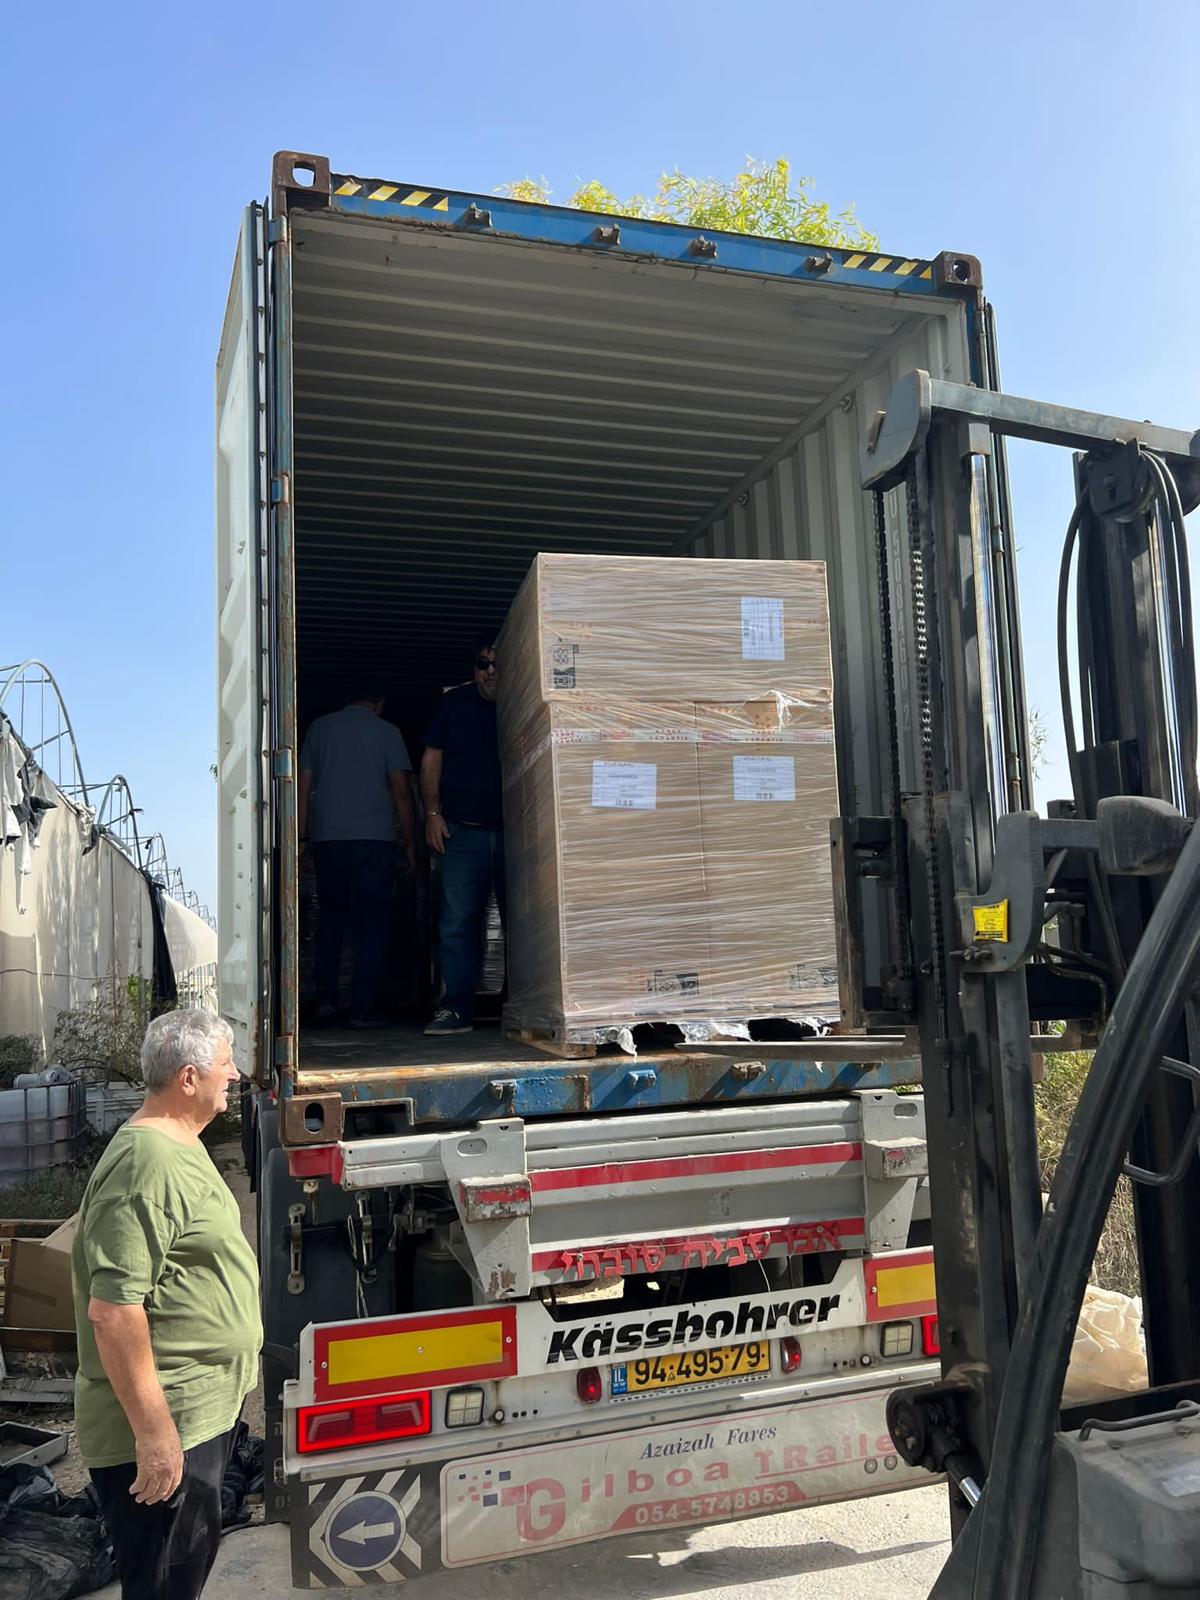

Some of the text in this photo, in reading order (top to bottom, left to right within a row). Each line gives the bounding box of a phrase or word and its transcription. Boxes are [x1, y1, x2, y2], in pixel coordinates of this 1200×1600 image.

[546, 1294, 841, 1364] Kässbohrer
[614, 1368, 625, 1383] IL
[639, 1426, 777, 1460] Azaizah Fares
[514, 1432, 898, 1542] Gilboa TRaile
[634, 1485, 790, 1525] 054-5748853
